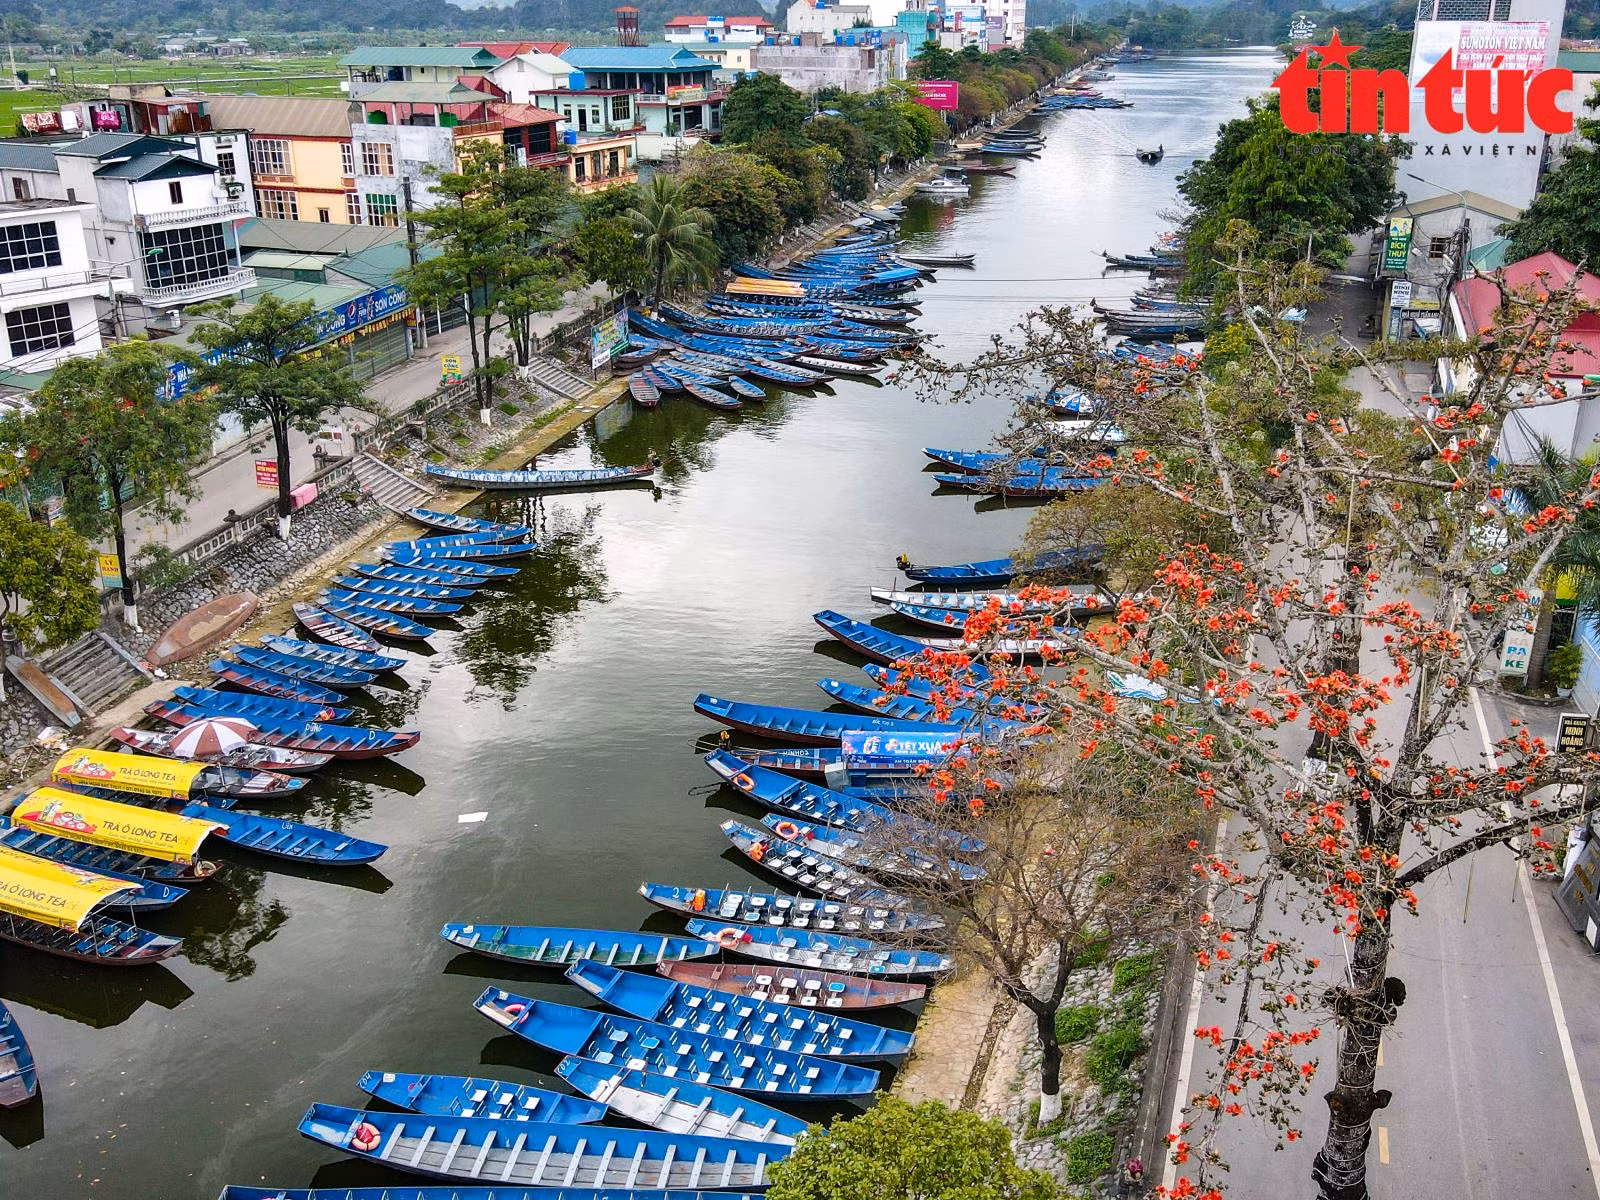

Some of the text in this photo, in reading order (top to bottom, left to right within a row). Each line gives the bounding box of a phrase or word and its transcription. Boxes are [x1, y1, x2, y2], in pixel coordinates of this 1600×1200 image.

[1525, 36, 1546, 49] NAM
[140, 769, 160, 779] LONG
[162, 772, 176, 782] TEA
[132, 827, 157, 839] LONG
[159, 832, 178, 843] TEA
[18, 888, 46, 901] LONG
[46, 895, 67, 907] TEA
[672, 887, 680, 899] 2
